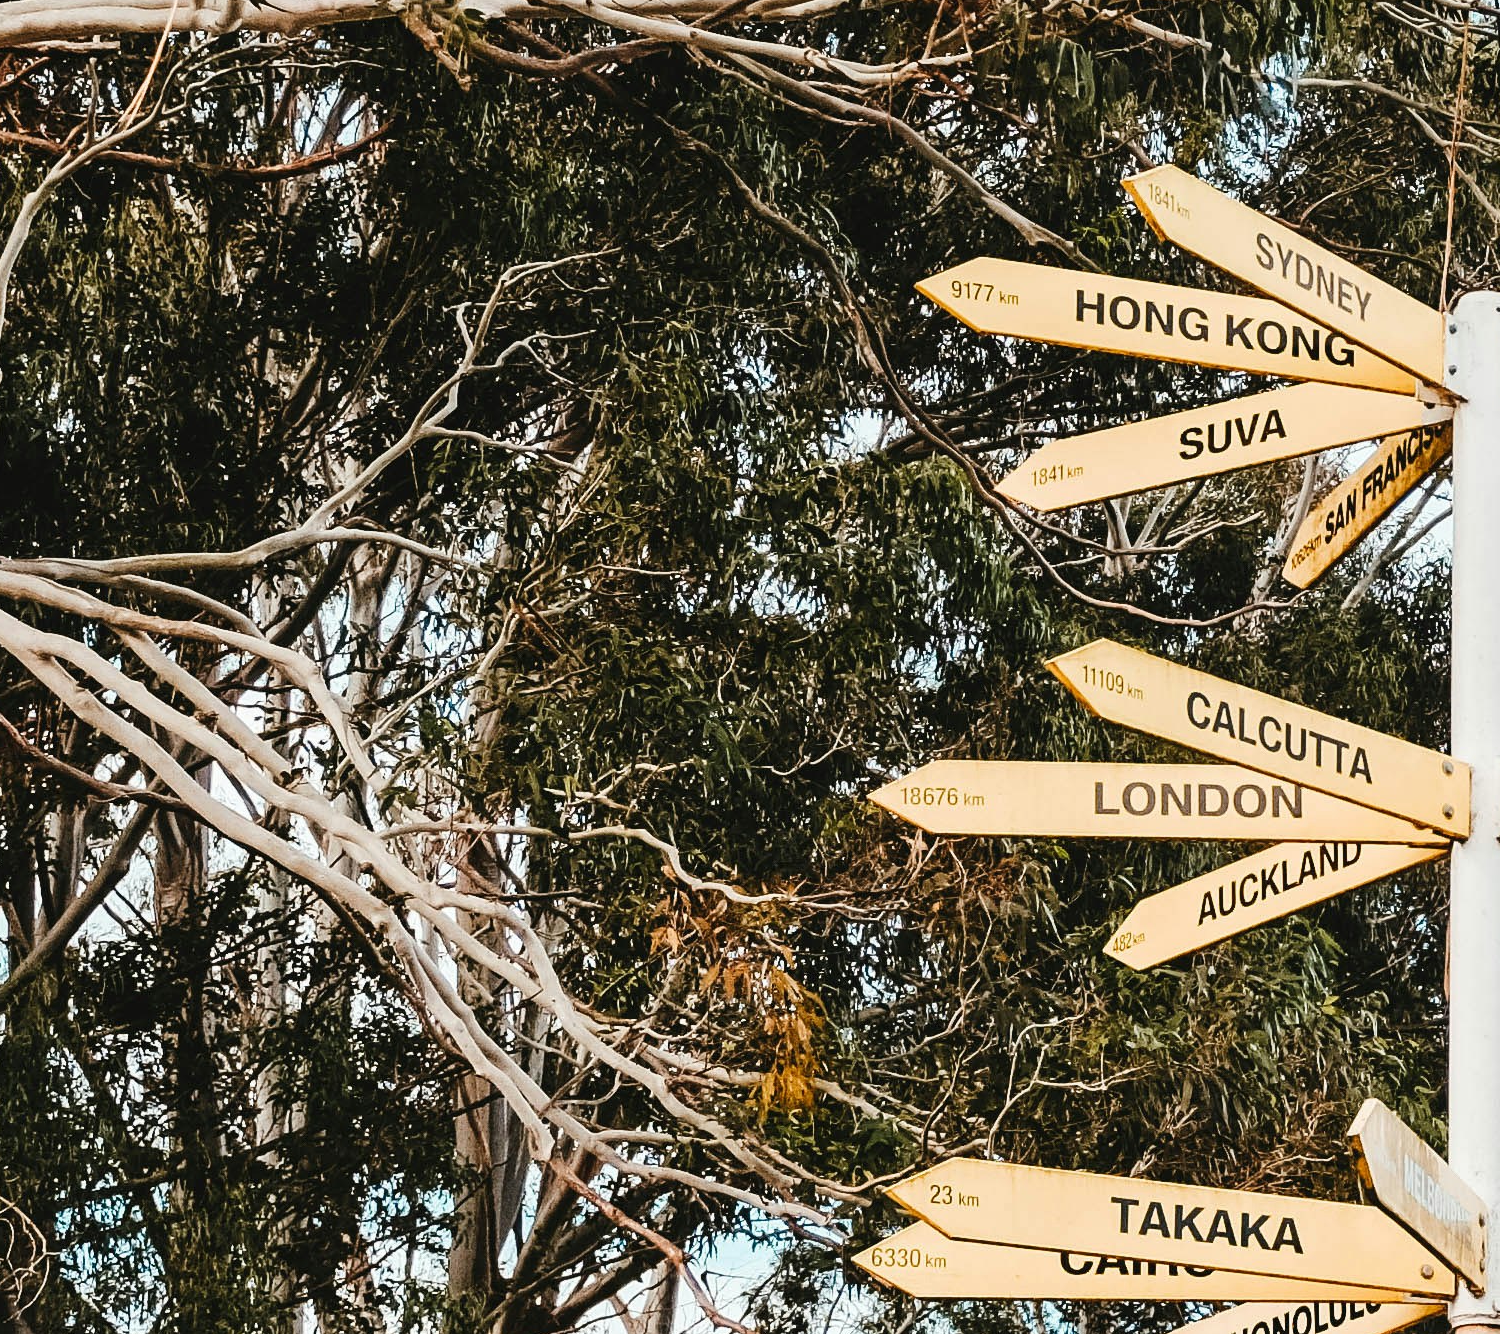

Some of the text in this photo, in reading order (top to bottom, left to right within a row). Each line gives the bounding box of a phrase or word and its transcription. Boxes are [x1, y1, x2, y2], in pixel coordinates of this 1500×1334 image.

[1148, 183, 1191, 220] 1841 km
[951, 279, 1020, 306] 9177 km
[1255, 232, 1373, 323] SYDNEY
[1075, 289, 1356, 368] HONG KONG
[1178, 408, 1288, 461] SUVA
[1031, 464, 1084, 487] 1841 km
[1324, 488, 1357, 545] SAN
[1082, 664, 1145, 701] 11109 km
[1187, 692, 1373, 785] CALCUTTA
[900, 786, 986, 808] 18676 km
[1094, 781, 1303, 820] LONDON
[1197, 842, 1363, 927] AUCKLAND
[929, 1183, 980, 1208] 23 km
[1110, 1195, 1305, 1255] TAKAKA
[871, 1247, 947, 1269] 6330 km
